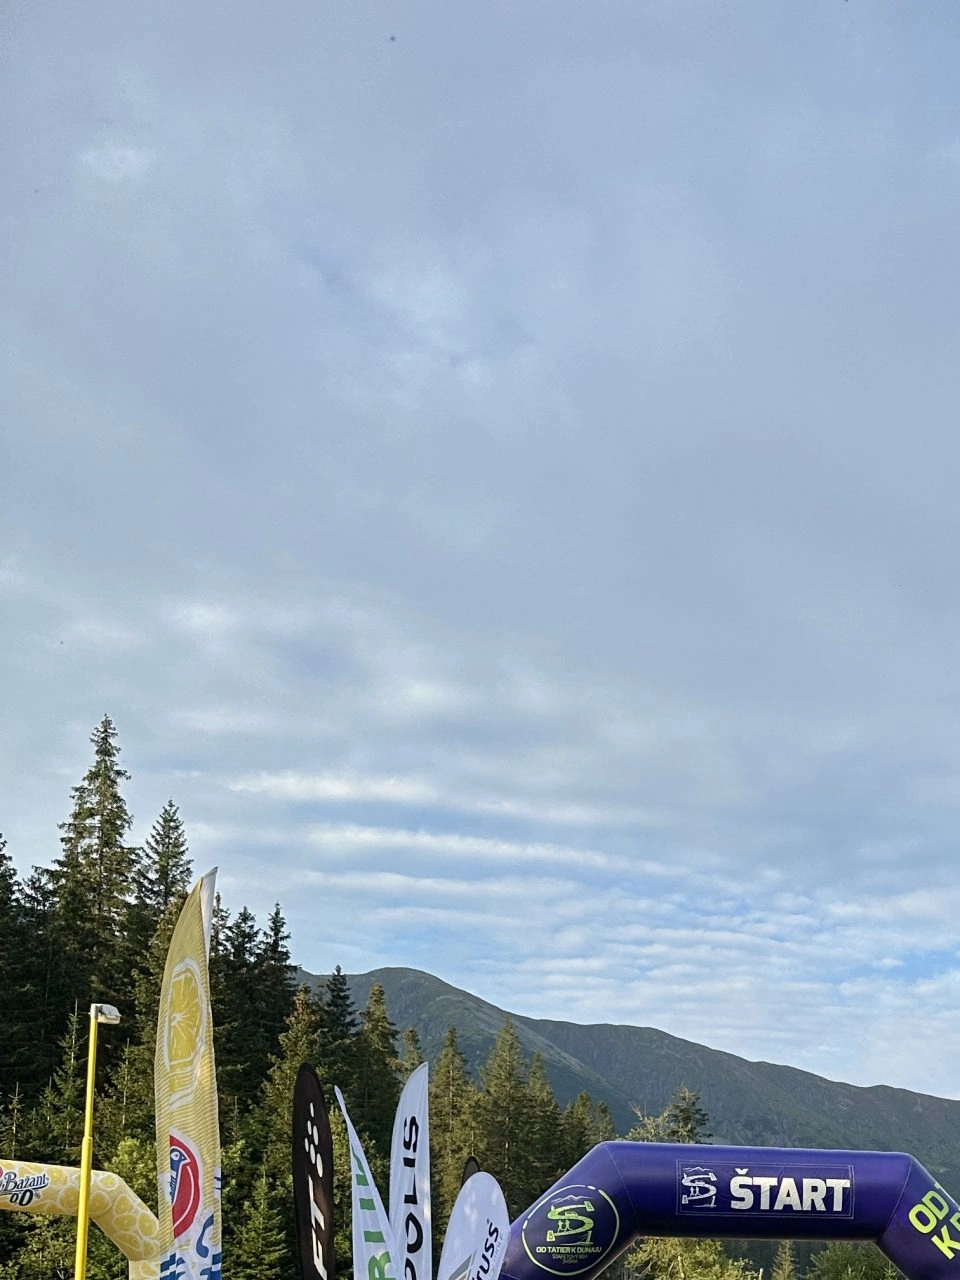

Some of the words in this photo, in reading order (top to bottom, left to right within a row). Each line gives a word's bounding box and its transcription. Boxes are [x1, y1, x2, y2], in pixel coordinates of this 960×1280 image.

[730, 1168, 850, 1212] ŠTART
[908, 1190, 949, 1234] OD
[536, 1246, 547, 1254] OD
